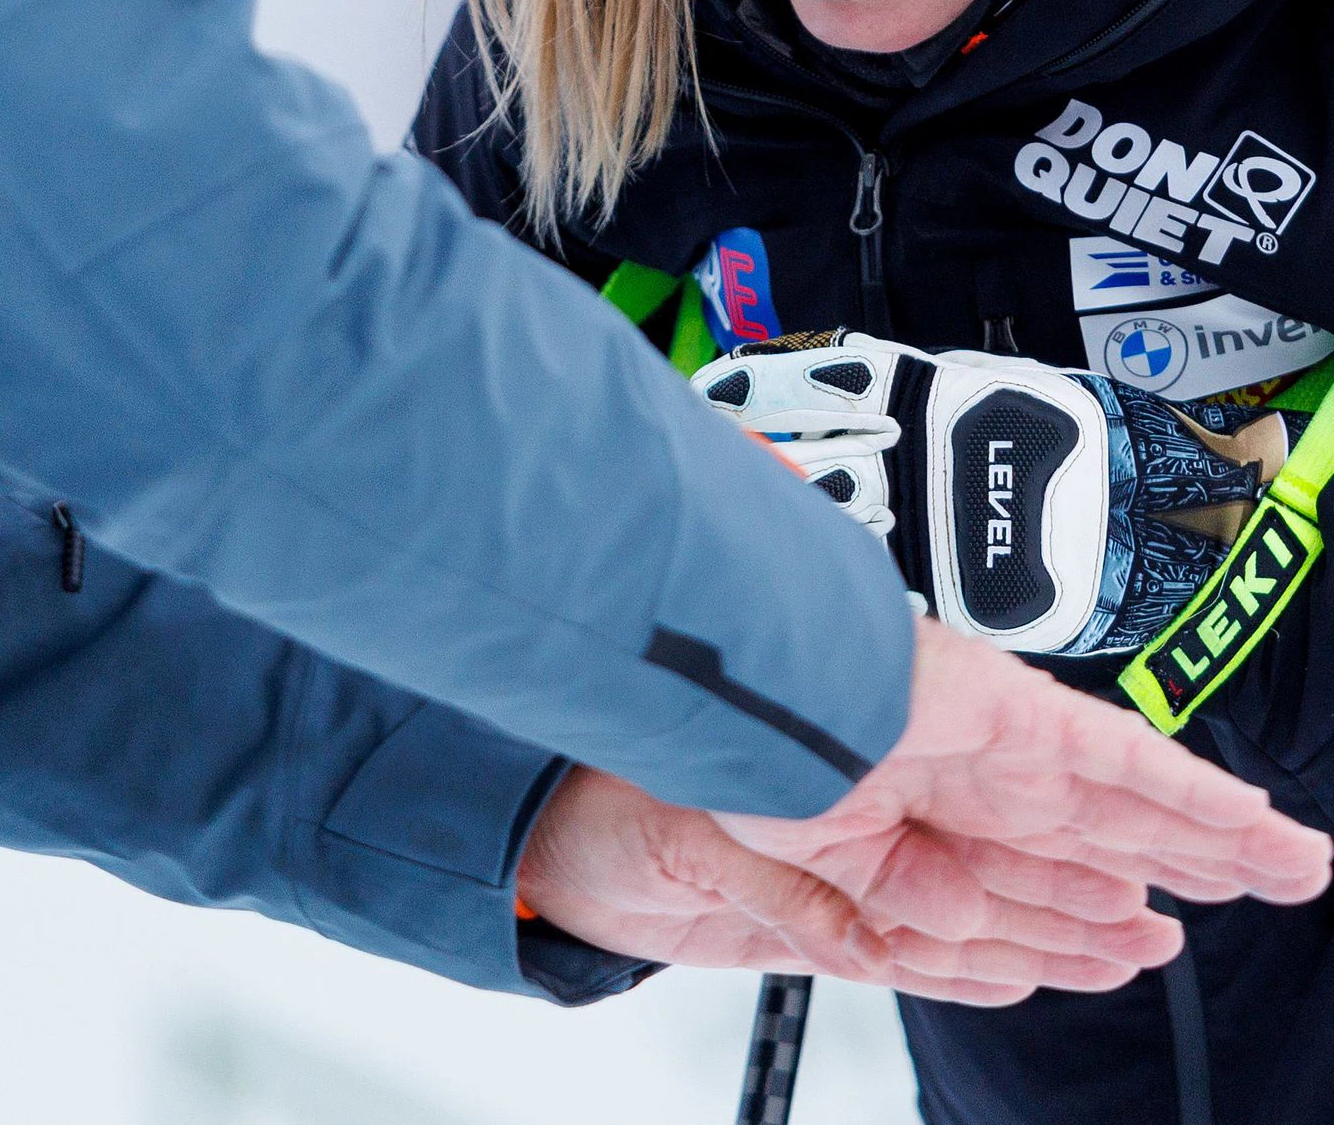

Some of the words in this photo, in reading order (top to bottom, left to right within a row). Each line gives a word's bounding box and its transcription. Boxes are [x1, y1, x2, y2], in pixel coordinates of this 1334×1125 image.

[1034, 97, 1221, 203] DON
[985, 440, 1013, 569] LEVEL
[1170, 527, 1294, 682] LEKI
